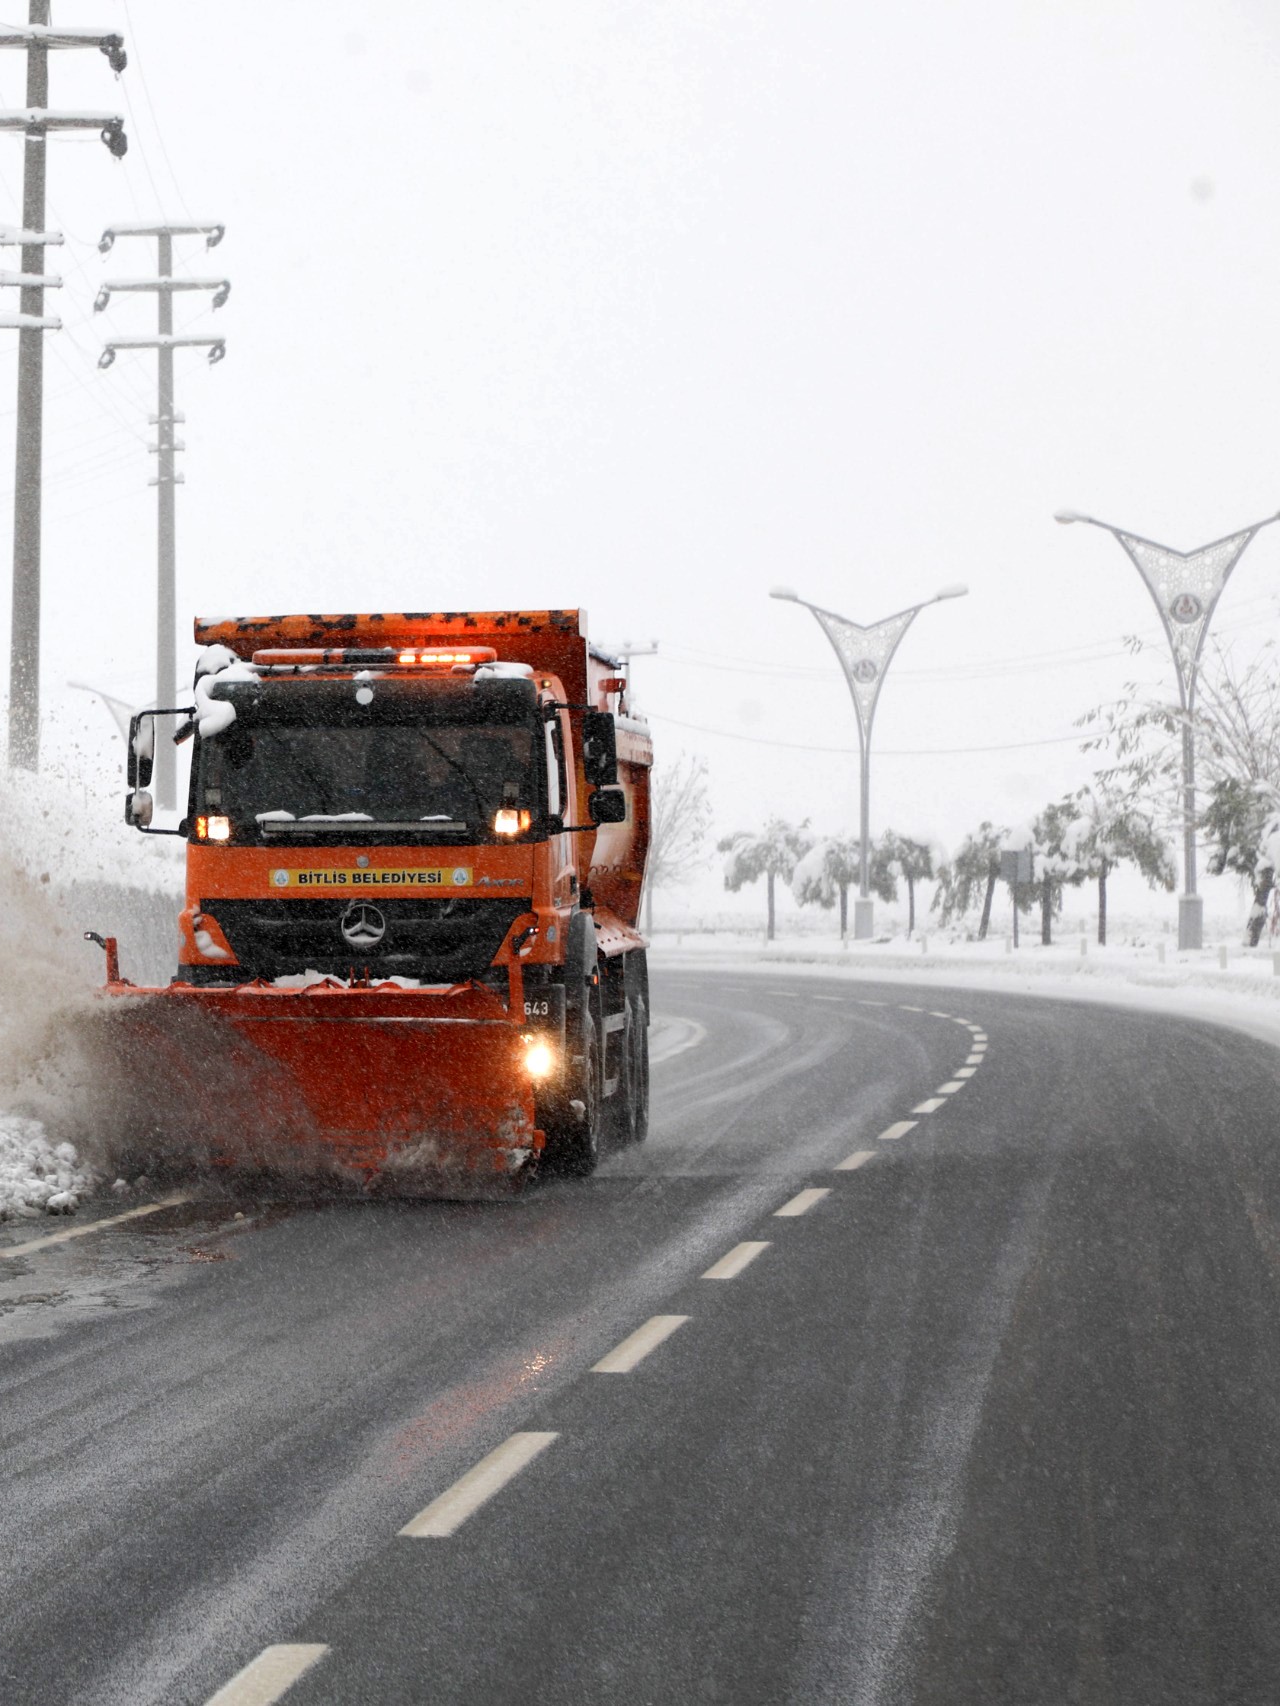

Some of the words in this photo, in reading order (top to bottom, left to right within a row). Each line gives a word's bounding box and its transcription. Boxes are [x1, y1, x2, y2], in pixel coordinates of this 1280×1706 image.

[298, 871, 347, 884] BİTLİS
[352, 870, 442, 884] BELEDİYESİ
[524, 1001, 548, 1015] 643
